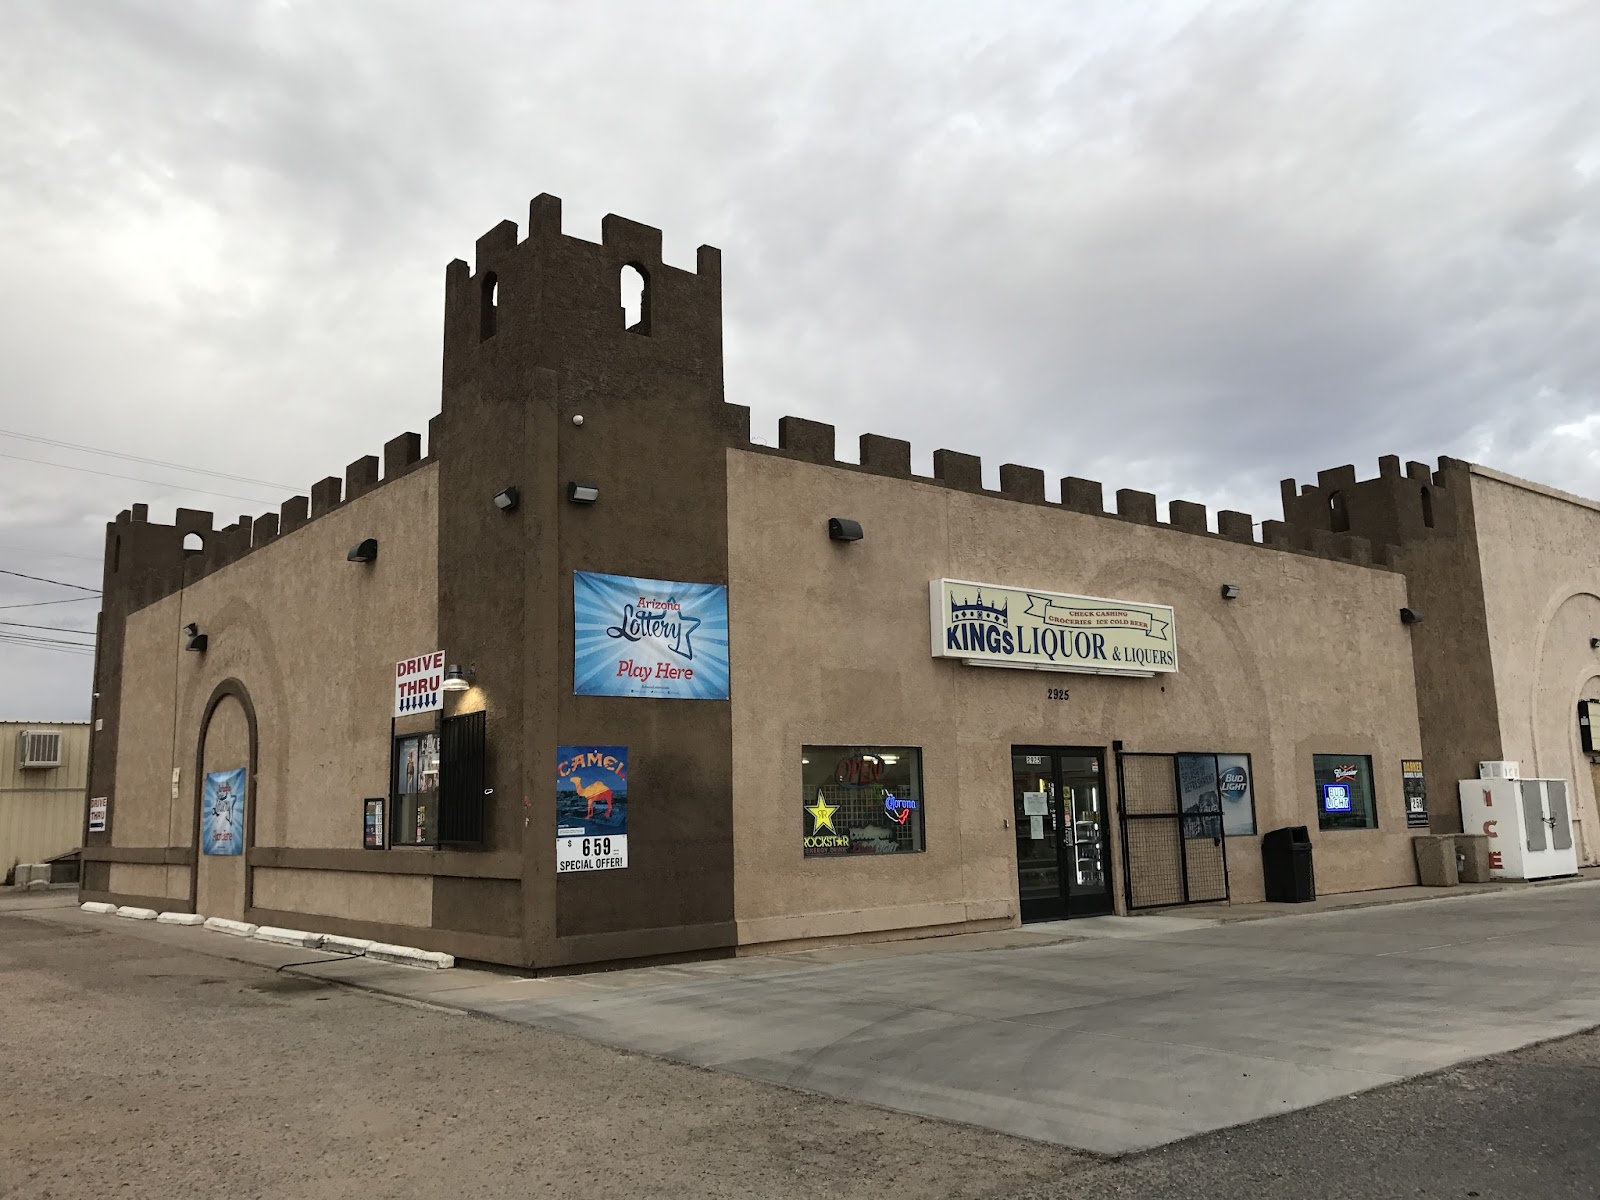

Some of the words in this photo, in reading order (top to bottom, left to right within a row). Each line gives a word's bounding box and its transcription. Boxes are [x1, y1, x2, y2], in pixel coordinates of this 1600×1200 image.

[637, 597, 681, 611] Arizona
[606, 603, 682, 651] Lottery
[1048, 615, 1092, 625] GROCERIES
[947, 622, 1015, 654] KINGS
[1016, 626, 1107, 661] LIQUOR
[1112, 648, 1121, 661] &
[1124, 646, 1173, 667] LIQUERS
[397, 652, 443, 677] DRIVE
[616, 659, 652, 682] Play
[654, 663, 693, 680] Here
[399, 675, 440, 697] THRU
[1047, 688, 1070, 700] 2925
[557, 752, 626, 779] CAMEL
[836, 758, 884, 784] OPEN
[1225, 773, 1244, 783] BUD
[1221, 782, 1247, 791] LIGHT
[1328, 787, 1346, 798] BUD
[90, 798, 107, 808] DRIVE
[885, 796, 917, 810] Corona
[1326, 797, 1349, 809] LIGHT
[91, 811, 105, 821] THRU
[567, 839, 573, 848] $
[559, 859, 594, 871] SPECIAL
[595, 857, 623, 869] OFFER!
